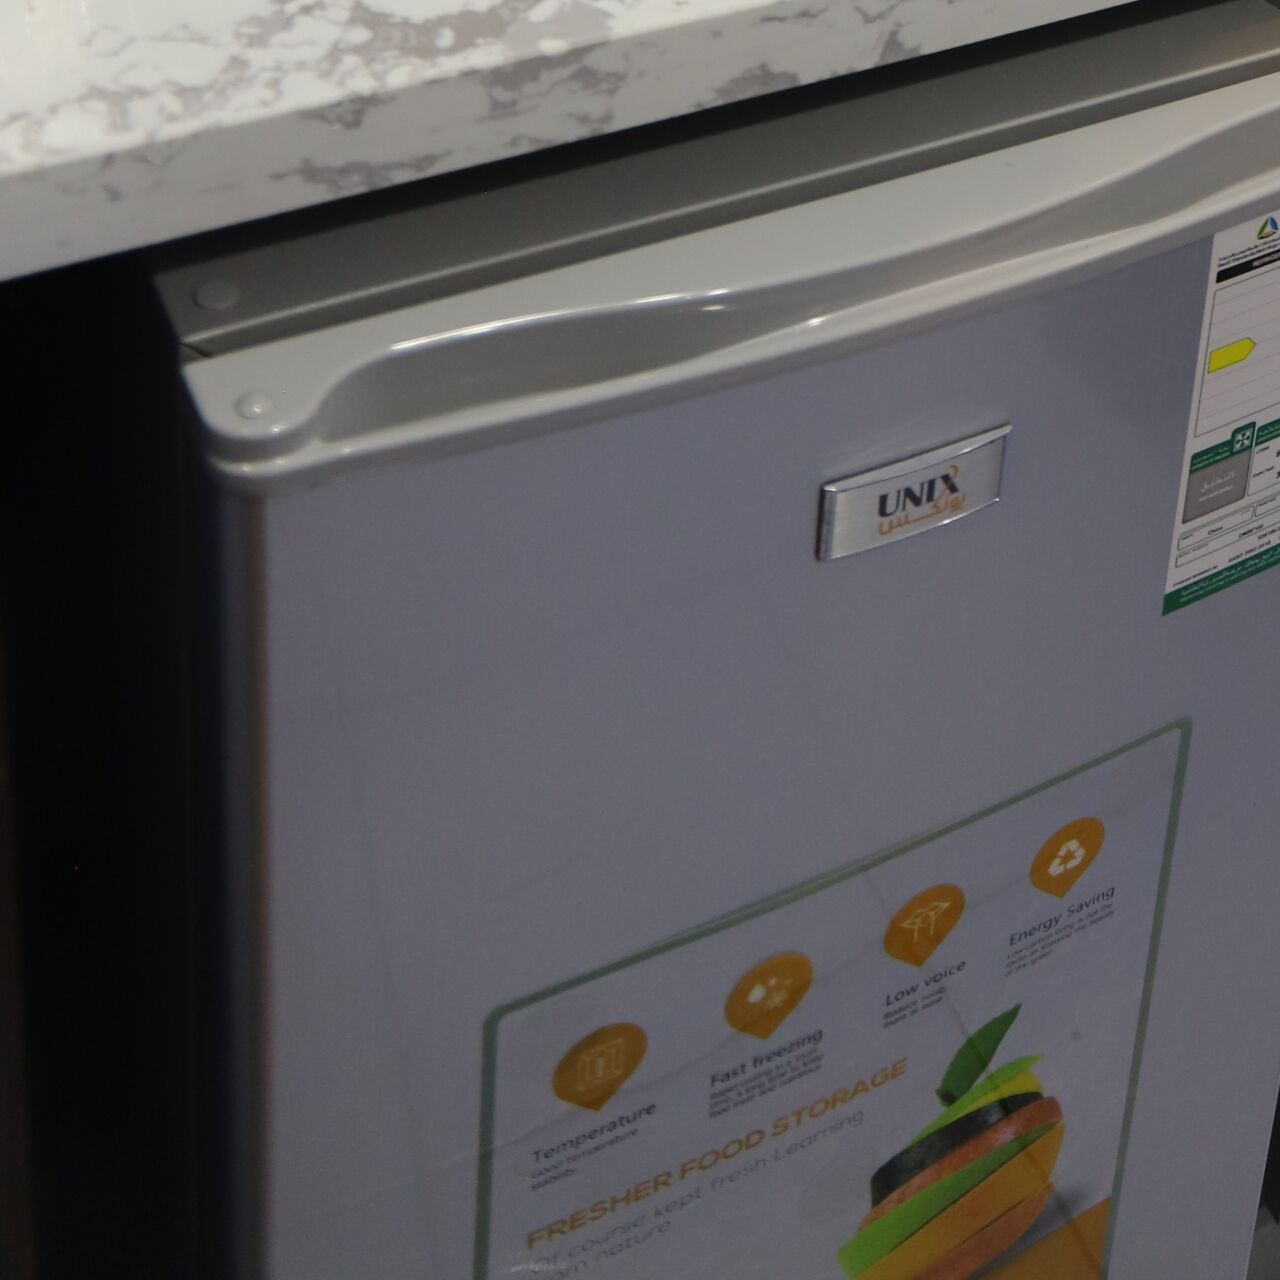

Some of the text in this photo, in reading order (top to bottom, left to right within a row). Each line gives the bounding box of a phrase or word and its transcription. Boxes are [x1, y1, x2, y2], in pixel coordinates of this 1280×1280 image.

[877, 472, 961, 518] UNIX
[1009, 886, 1115, 946] Energy Saving
[886, 961, 966, 1007] Low voice
[709, 1028, 824, 1087] Fast freezing
[526, 1057, 909, 1251] FRESHER FOOD STORAGE
[532, 1103, 657, 1163] Temperature
[568, 1215, 647, 1259] course
[653, 1186, 703, 1219] kept
[711, 1156, 769, 1191] fresh
[773, 1109, 864, 1162] Learning
[599, 1219, 672, 1260] nature
